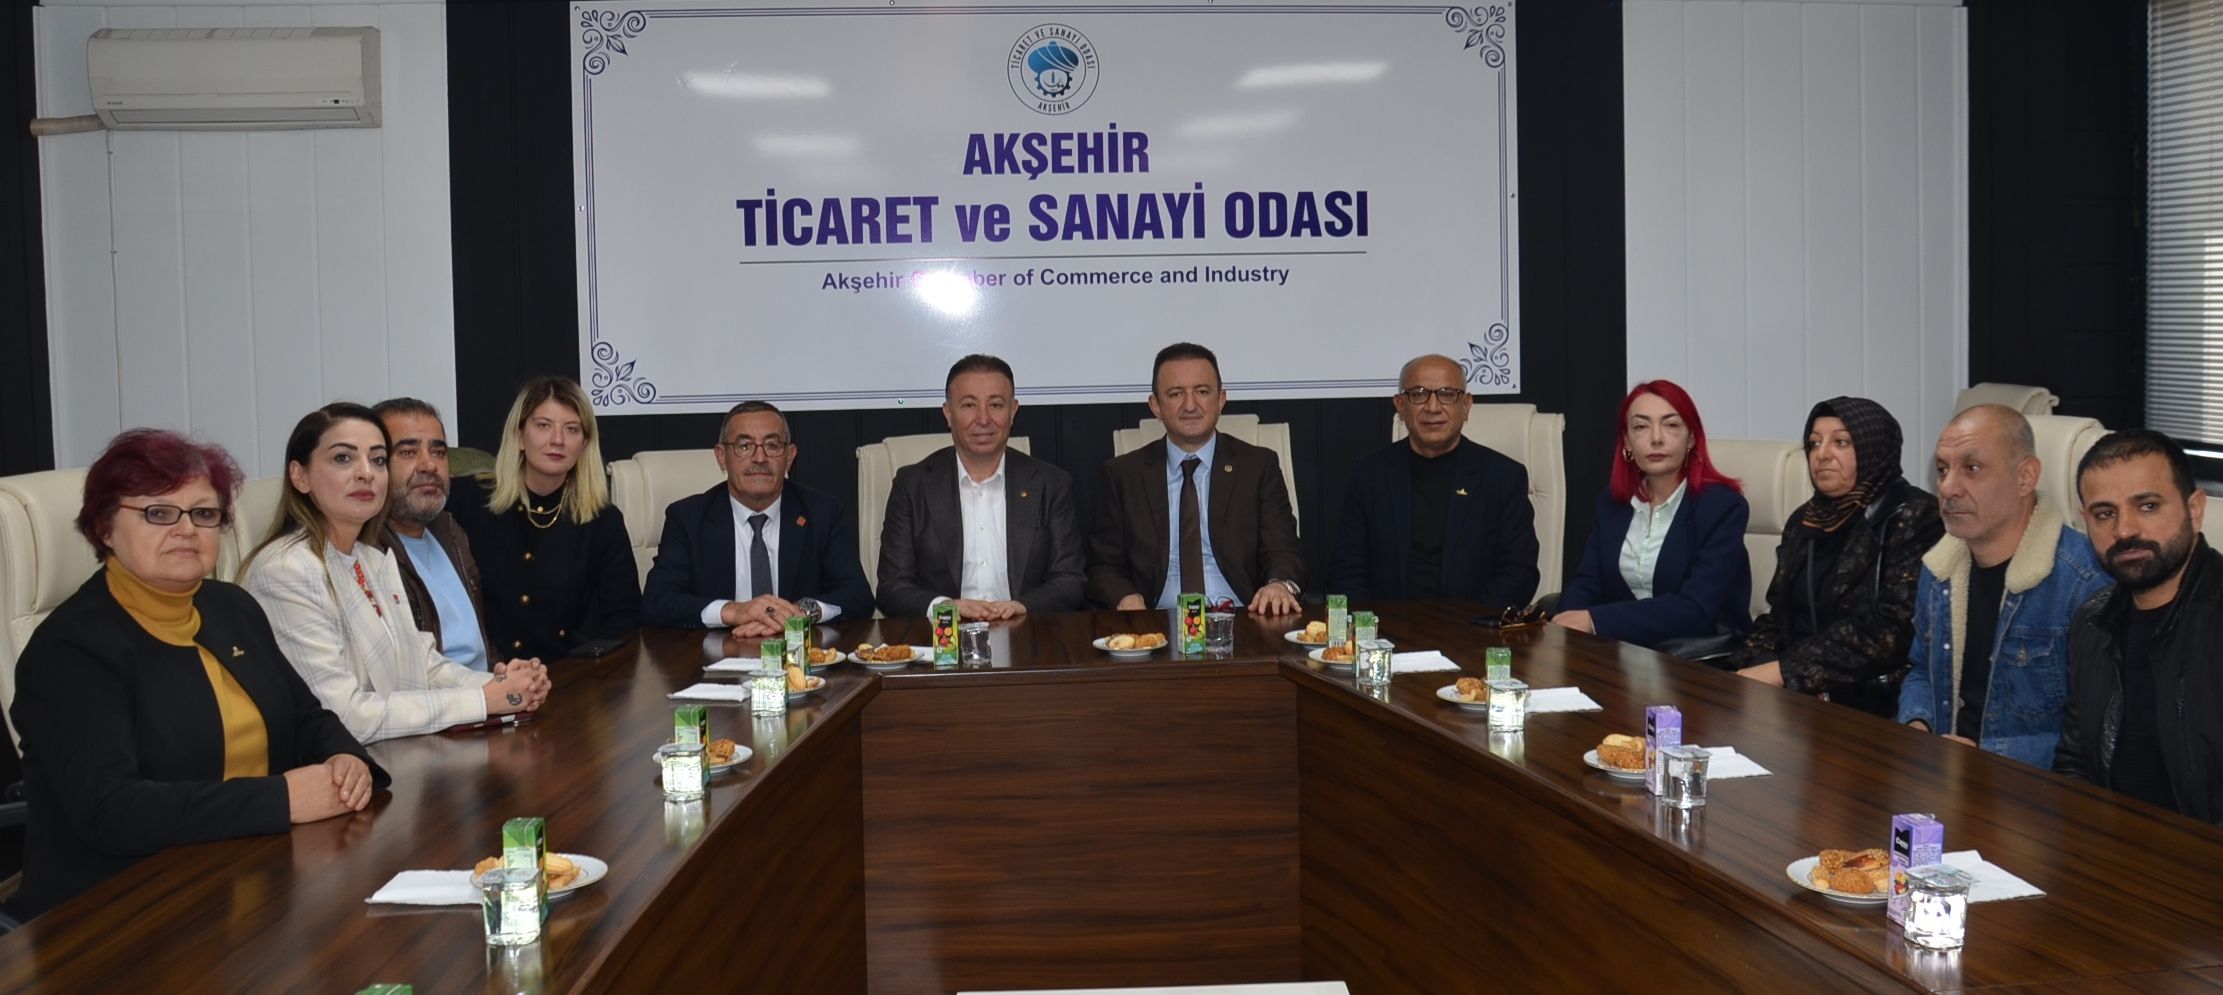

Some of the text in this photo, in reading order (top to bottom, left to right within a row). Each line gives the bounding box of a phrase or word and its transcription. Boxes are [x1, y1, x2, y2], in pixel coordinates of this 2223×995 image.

[1011, 26, 1096, 69] TİCARET VE SANAYİ ODASI
[1037, 100, 1070, 114] AKŞEHİR
[962, 122, 1150, 181] AKŞEHİR
[736, 181, 1370, 247] TİCARET ve SANAYİ ODASI
[822, 272, 902, 293] Akşehir
[1013, 268, 1034, 286] of
[1040, 268, 1153, 286] Commerce
[1160, 266, 1198, 284] and
[1205, 265, 1290, 286] Industry
